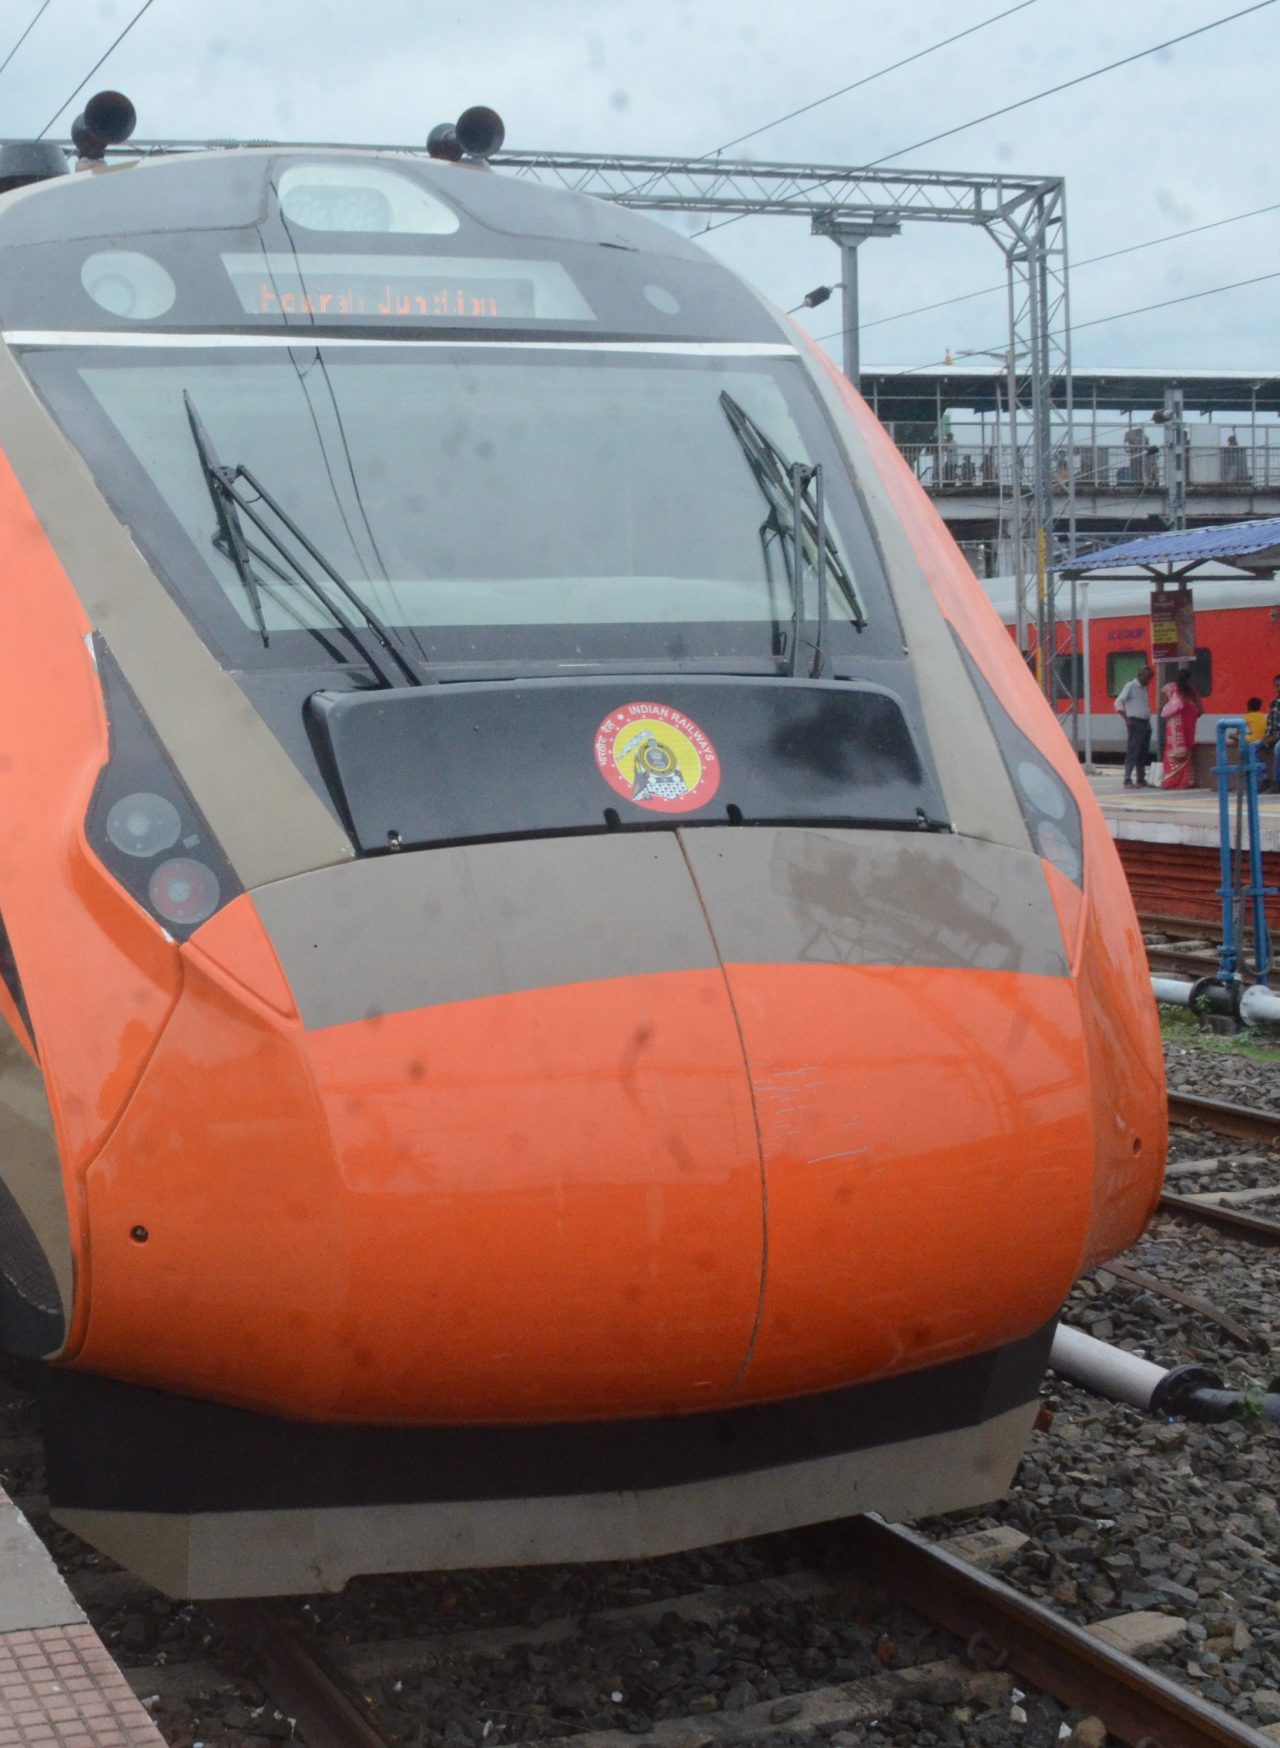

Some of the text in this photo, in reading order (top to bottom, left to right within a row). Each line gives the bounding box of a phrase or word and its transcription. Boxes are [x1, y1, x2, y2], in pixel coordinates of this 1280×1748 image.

[600, 719, 615, 733] रेल
[628, 704, 715, 761] INDIAN RAILWAYS
